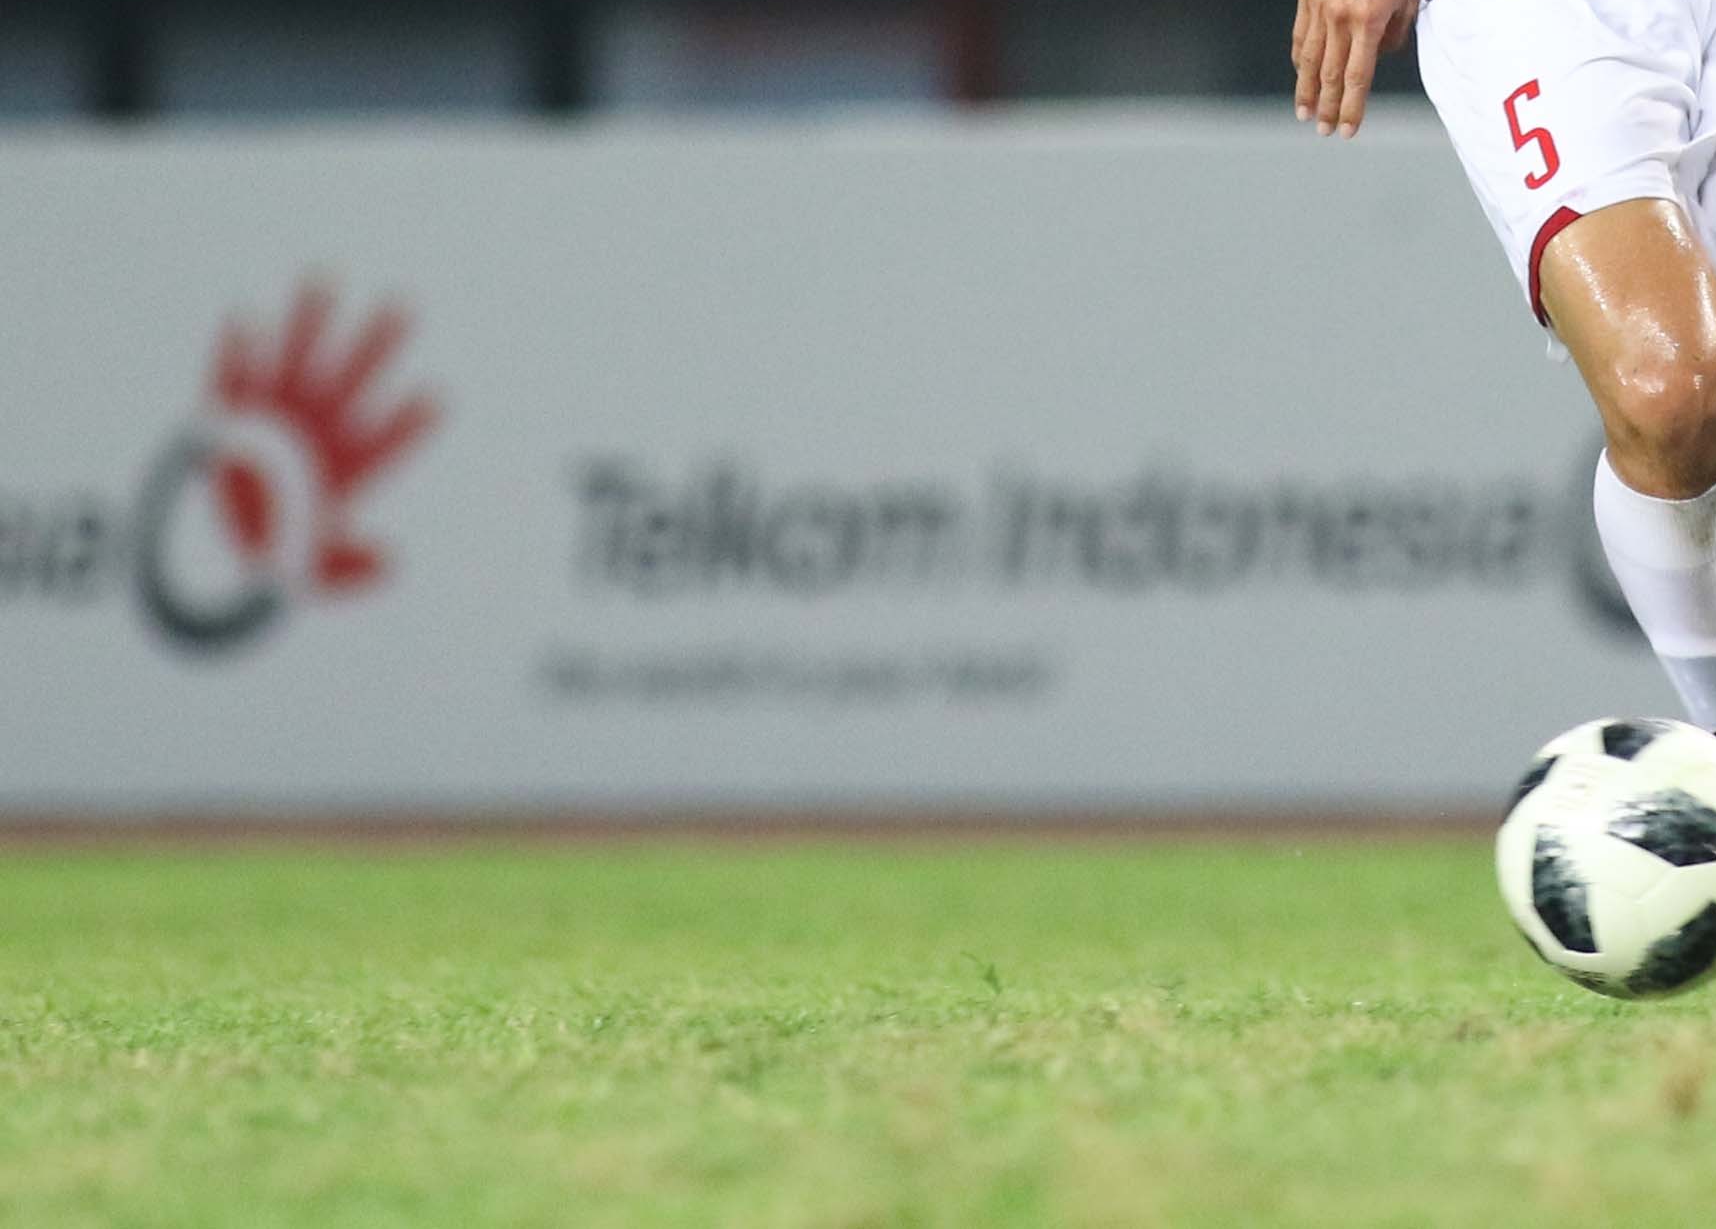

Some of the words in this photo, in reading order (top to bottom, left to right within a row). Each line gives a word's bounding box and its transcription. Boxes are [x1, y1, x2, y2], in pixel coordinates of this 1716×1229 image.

[1503, 78, 1560, 190] 5
[572, 452, 952, 600] Telkom
[985, 452, 1543, 600] Indonesia
